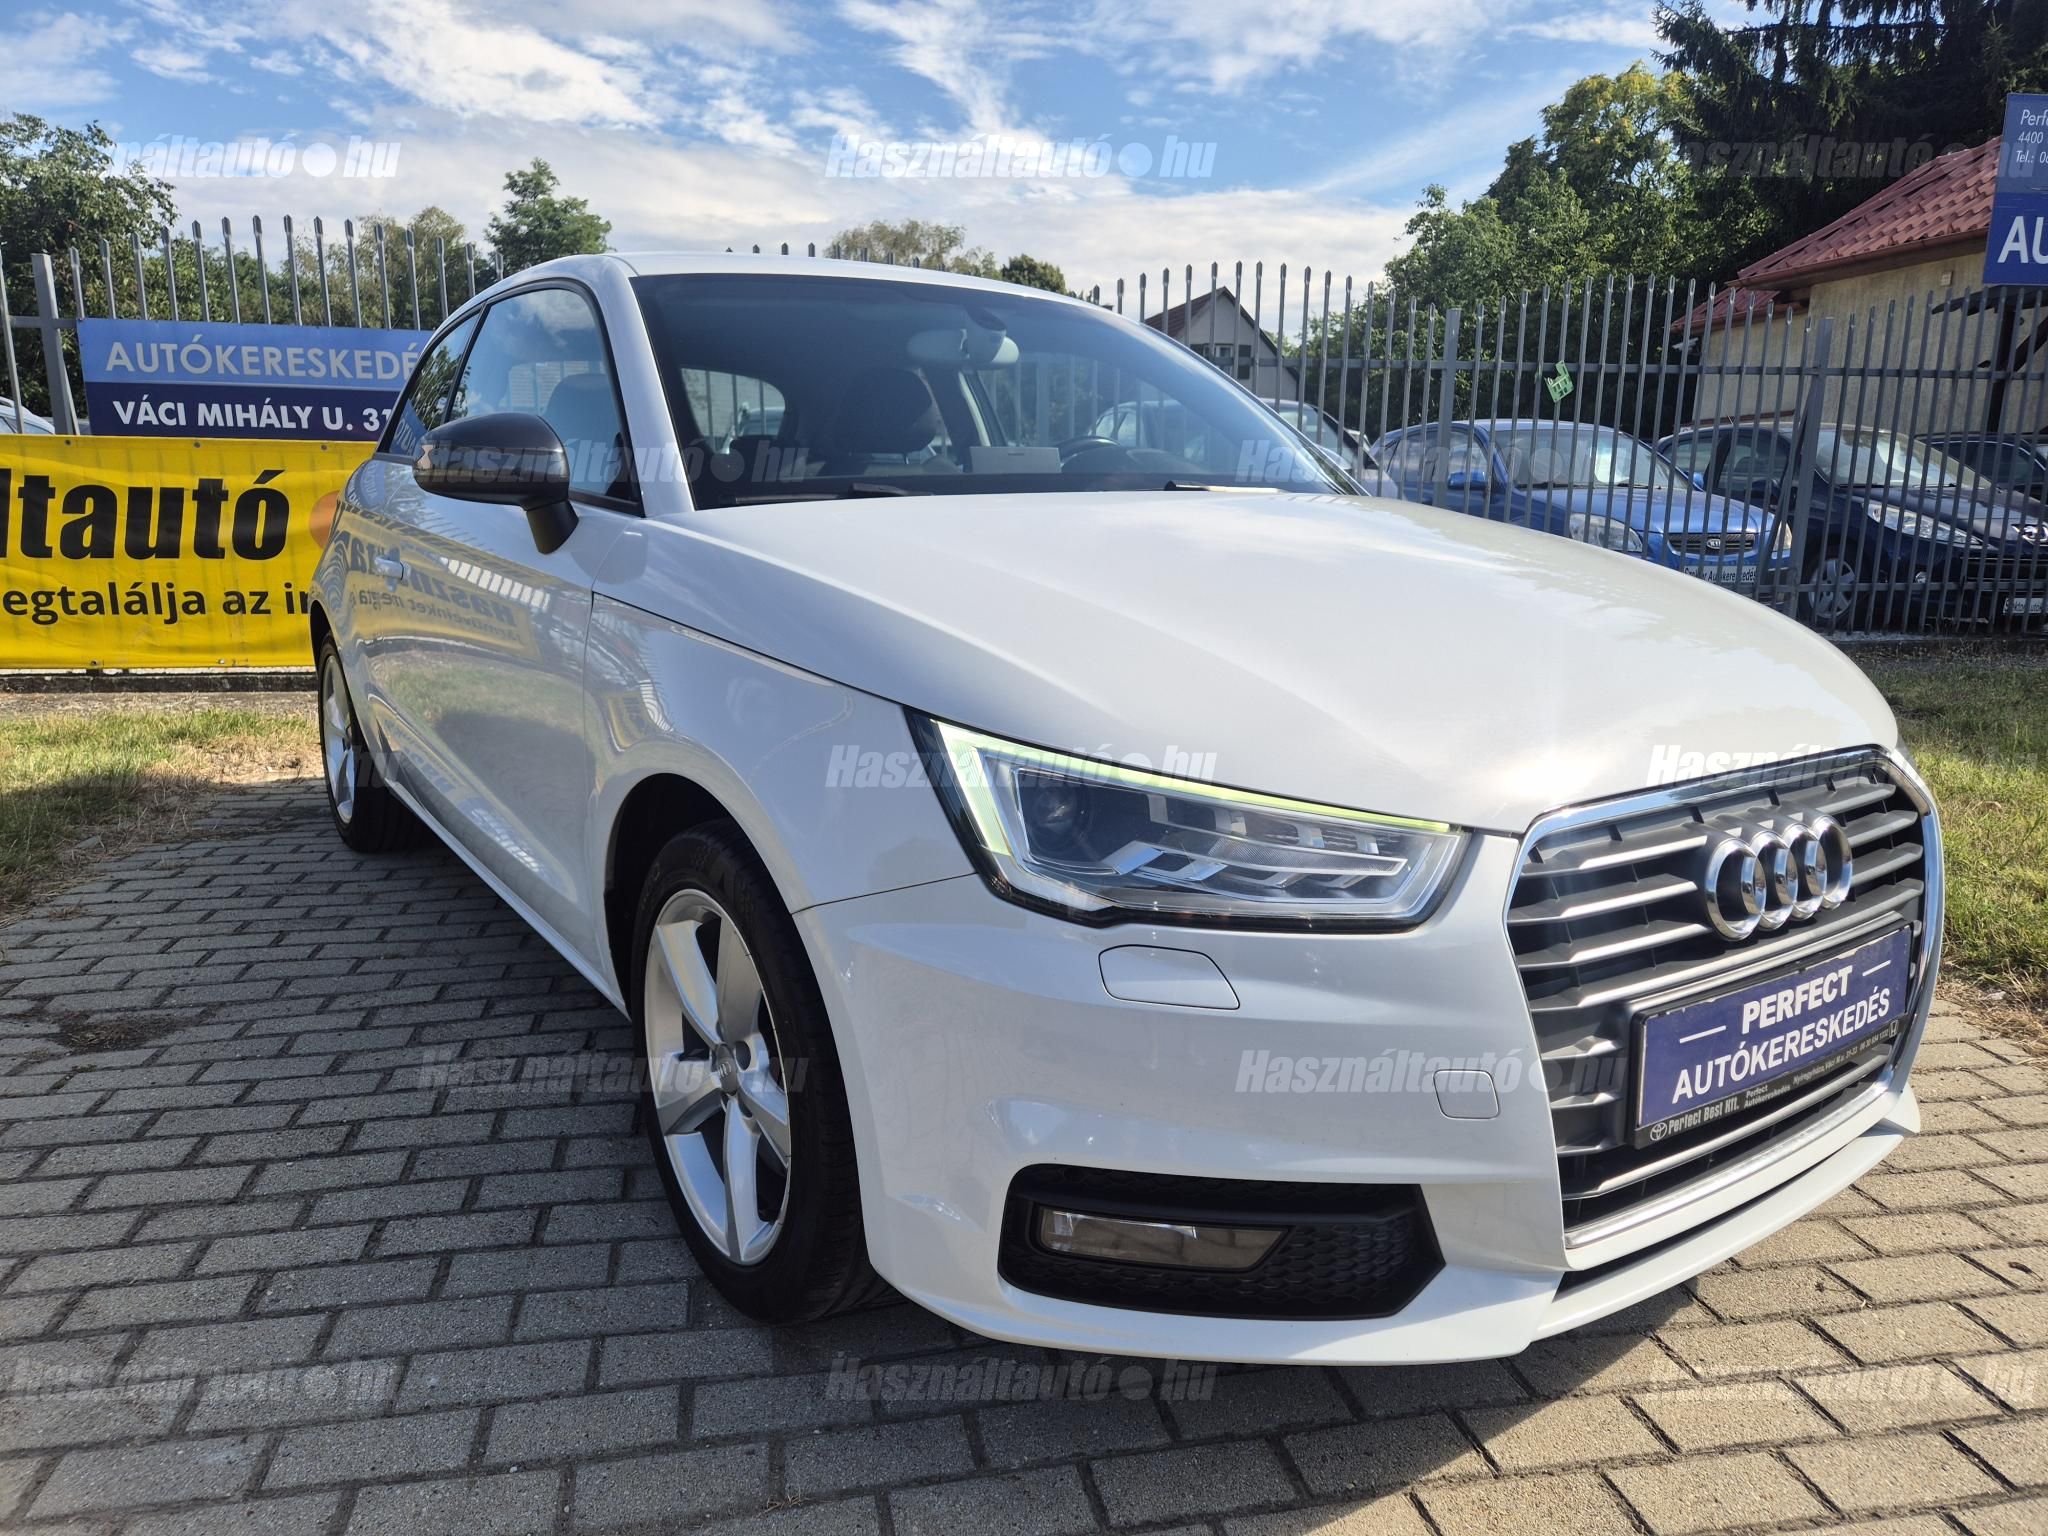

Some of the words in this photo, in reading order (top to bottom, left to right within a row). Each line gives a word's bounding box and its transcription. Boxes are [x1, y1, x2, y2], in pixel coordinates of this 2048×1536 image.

[2018, 131, 2044, 144] 4400
[112, 394, 187, 426] VÁCI
[197, 397, 313, 429] MIHÁLY
[322, 406, 353, 431] U.
[2, 581, 206, 626] egtalálja
[222, 589, 272, 615] az
[1741, 966, 1853, 1035] PERFECT
[1671, 985, 1891, 1105] AUTÓKERESKEDÉS
[1746, 1084, 1769, 1099] Perfect
[1668, 1109, 1702, 1135] Perfect
[1703, 1102, 1723, 1121] Best
